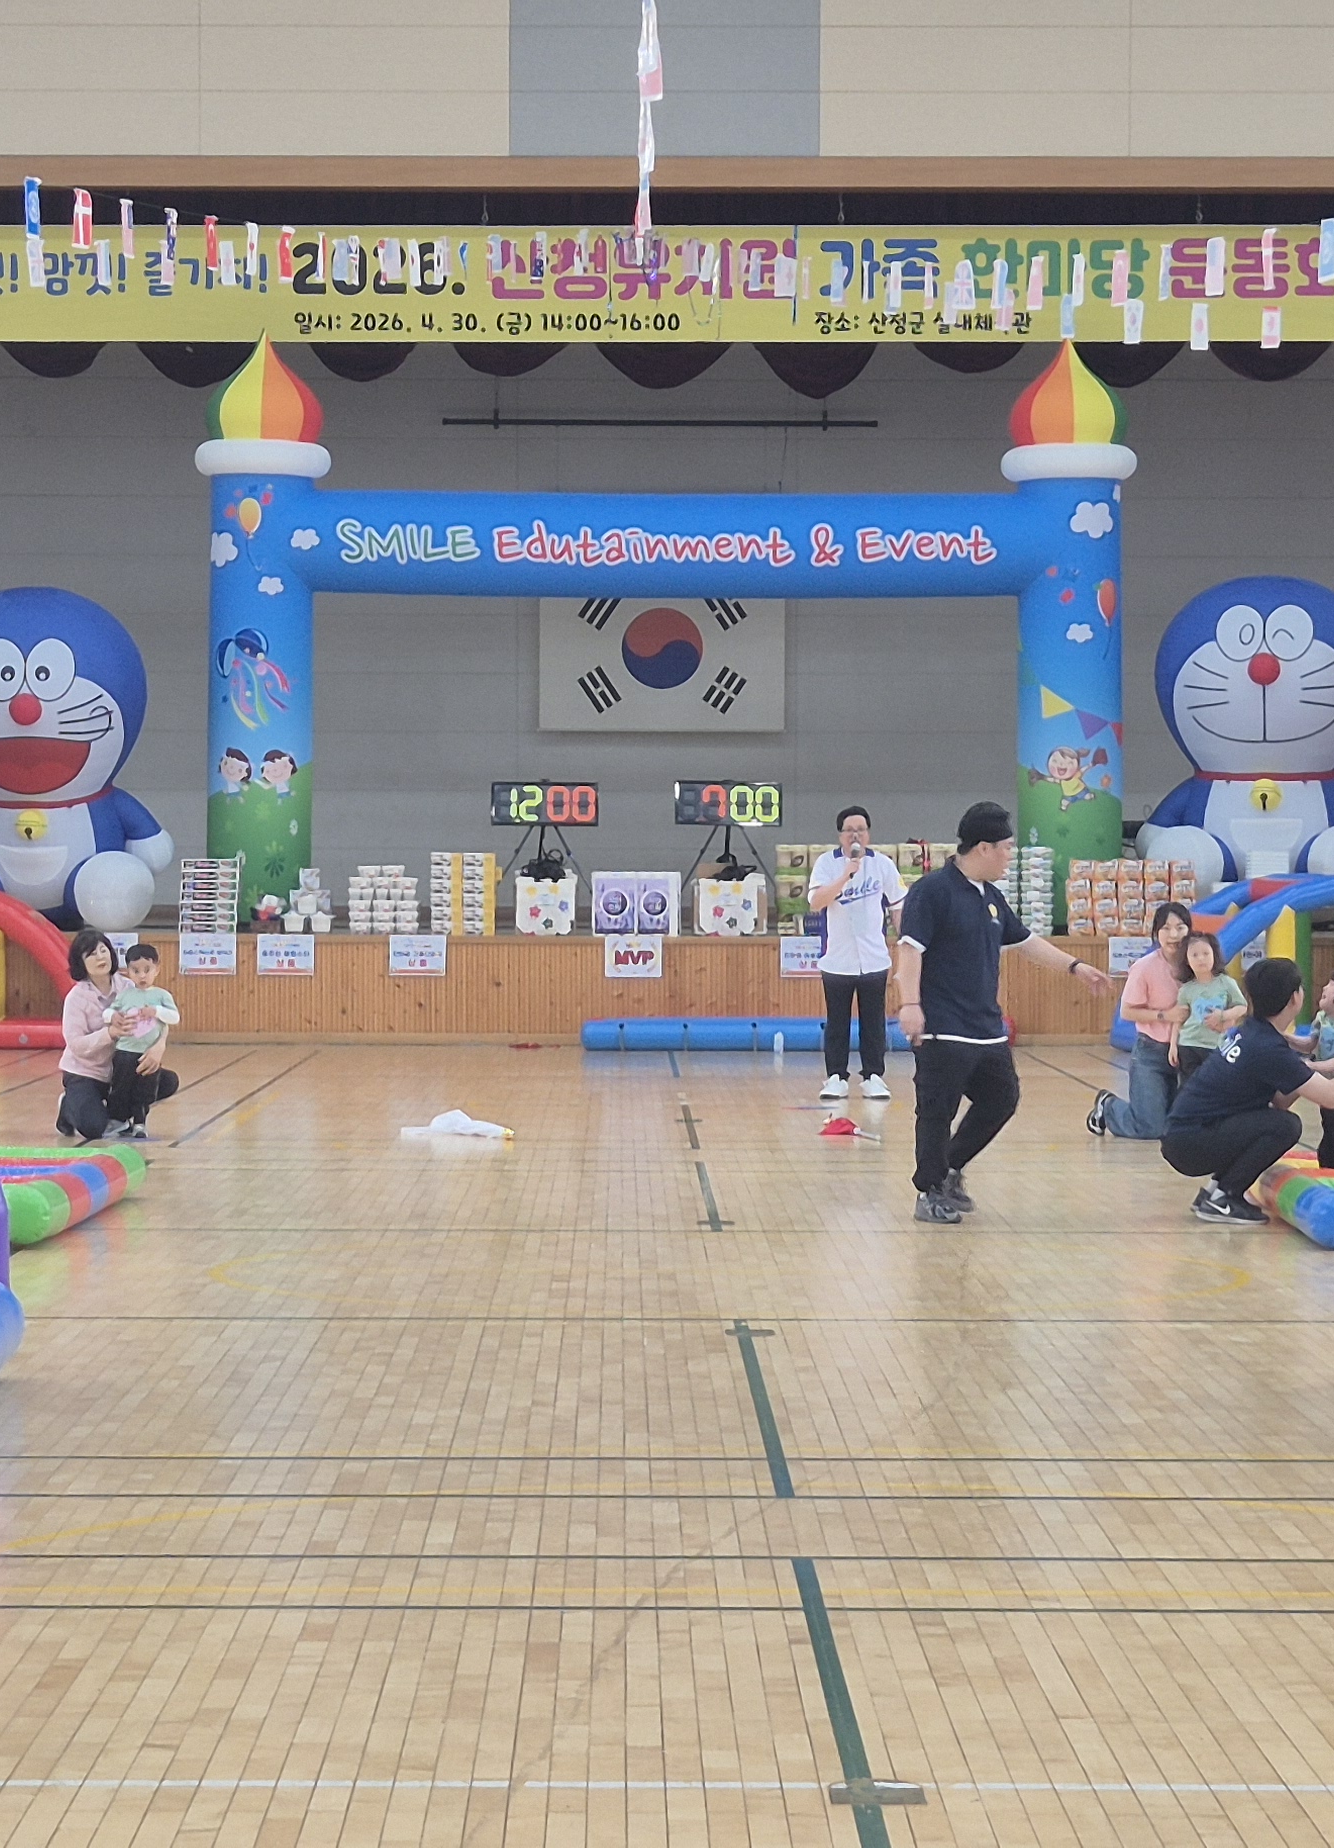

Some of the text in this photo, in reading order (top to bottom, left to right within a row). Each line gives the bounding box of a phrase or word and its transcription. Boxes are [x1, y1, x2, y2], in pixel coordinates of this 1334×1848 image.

[292, 241, 466, 296] 2026.
[819, 238, 941, 300] 가족
[960, 237, 1151, 300] 한마당
[293, 311, 342, 335] 일시:
[350, 312, 412, 333] 2026.
[420, 312, 443, 333] 4.
[451, 312, 487, 333] 30.
[495, 312, 533, 336] (금)
[540, 312, 681, 332] 14:00~16:00
[814, 311, 860, 335] 장소:
[338, 520, 995, 565] SMILE Edutainment & Event
[614, 949, 655, 966] MVP
